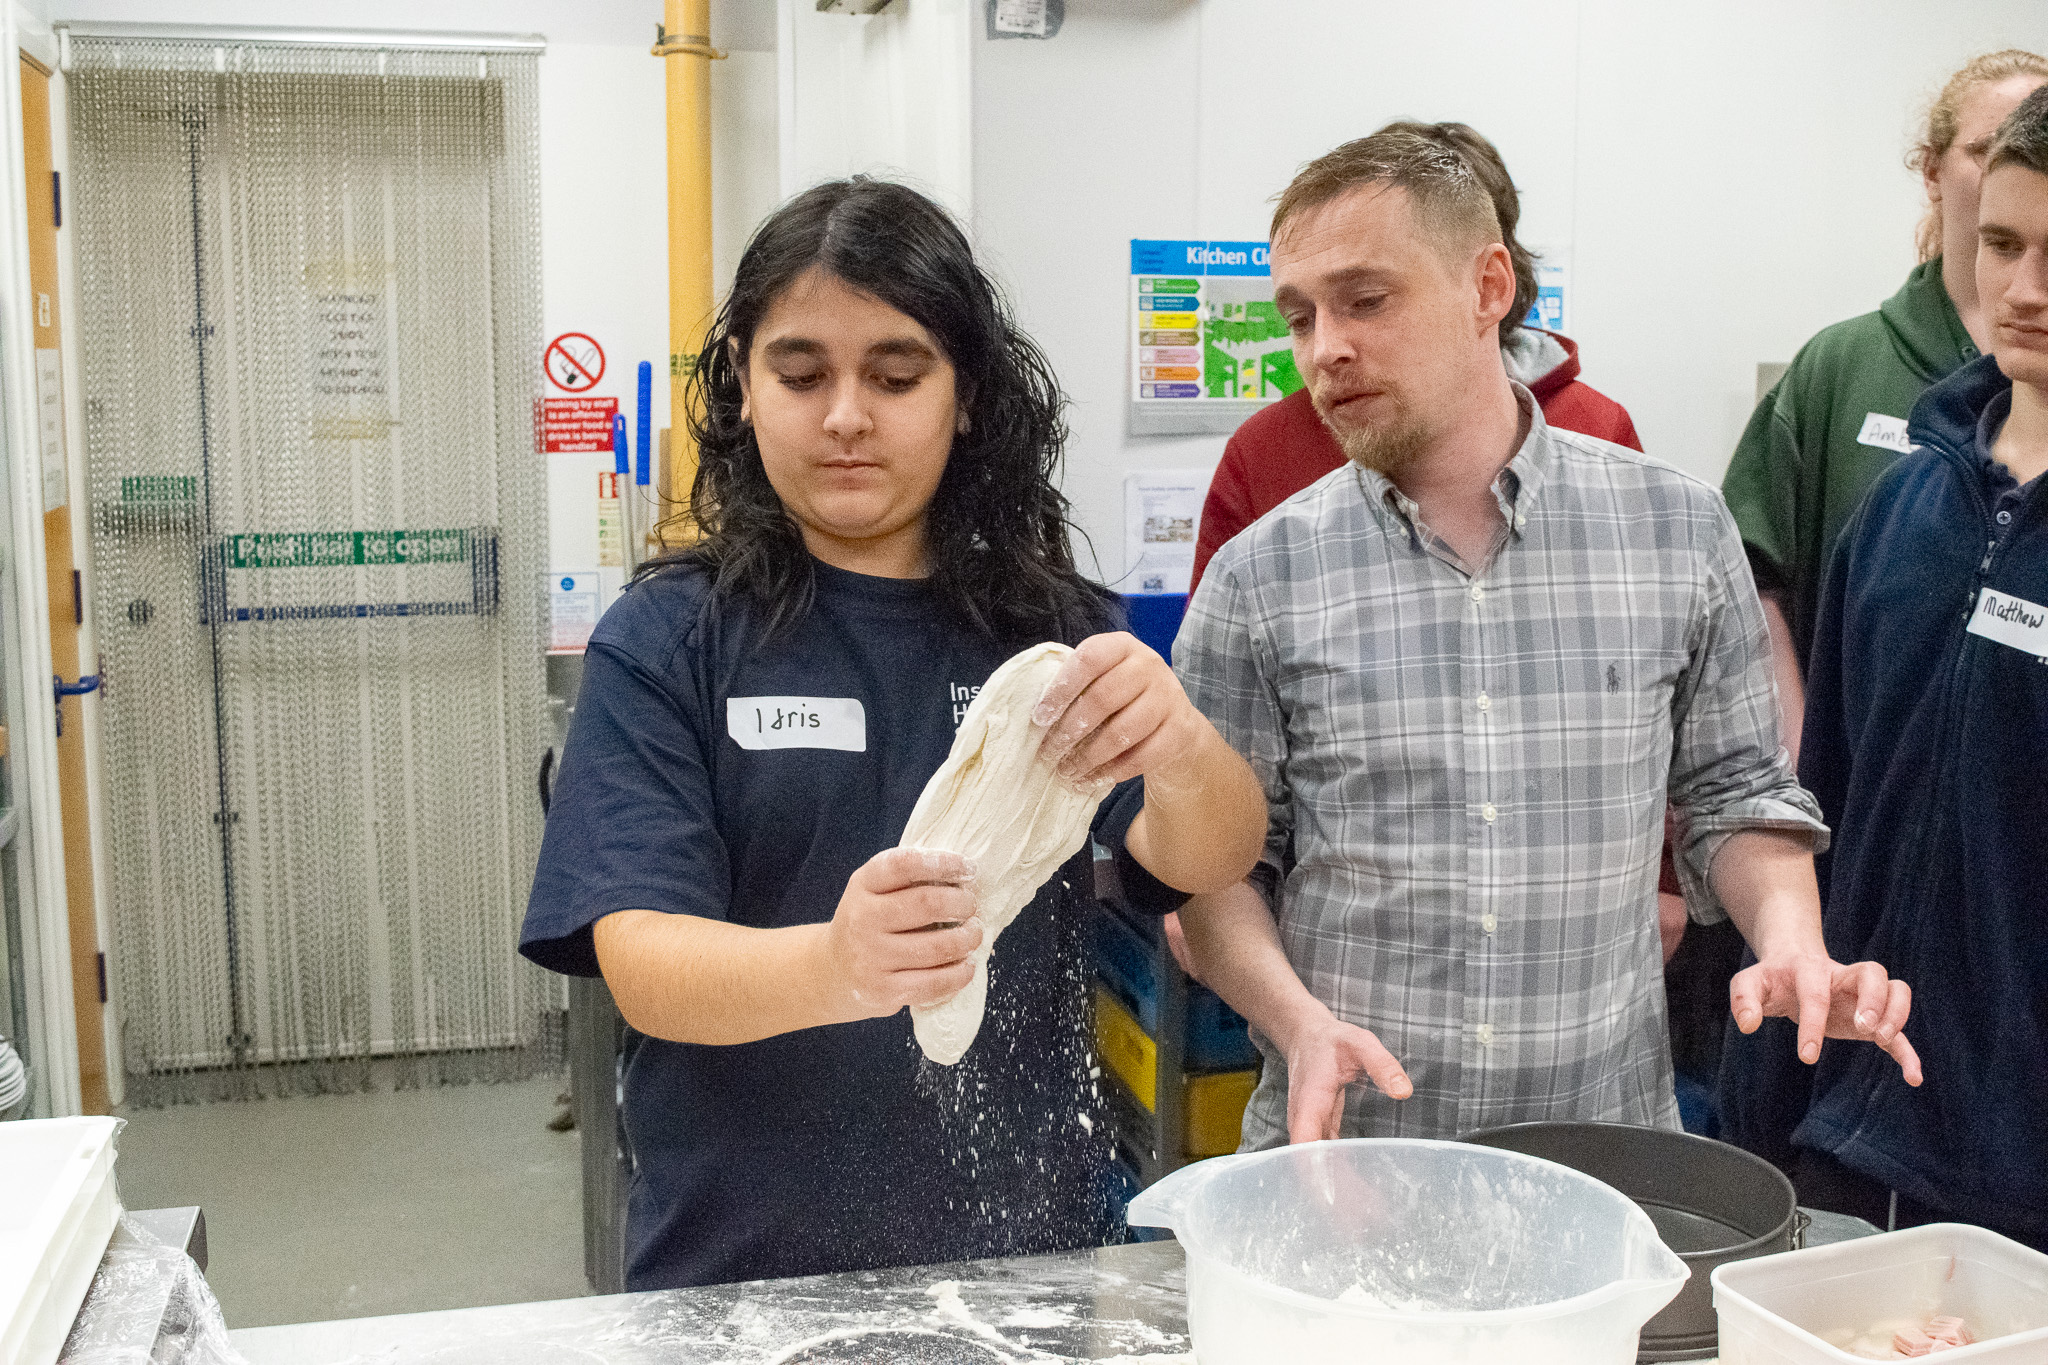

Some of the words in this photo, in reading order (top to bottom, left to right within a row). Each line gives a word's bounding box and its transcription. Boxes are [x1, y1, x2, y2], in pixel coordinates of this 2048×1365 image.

[1186, 246, 1247, 265] Kitchen
[541, 400, 580, 410] moking
[541, 421, 582, 430] herever
[1867, 422, 1908, 447] Amb
[1983, 595, 2045, 629] Matthew
[950, 682, 980, 702] Ins
[756, 703, 821, 734] Idris
